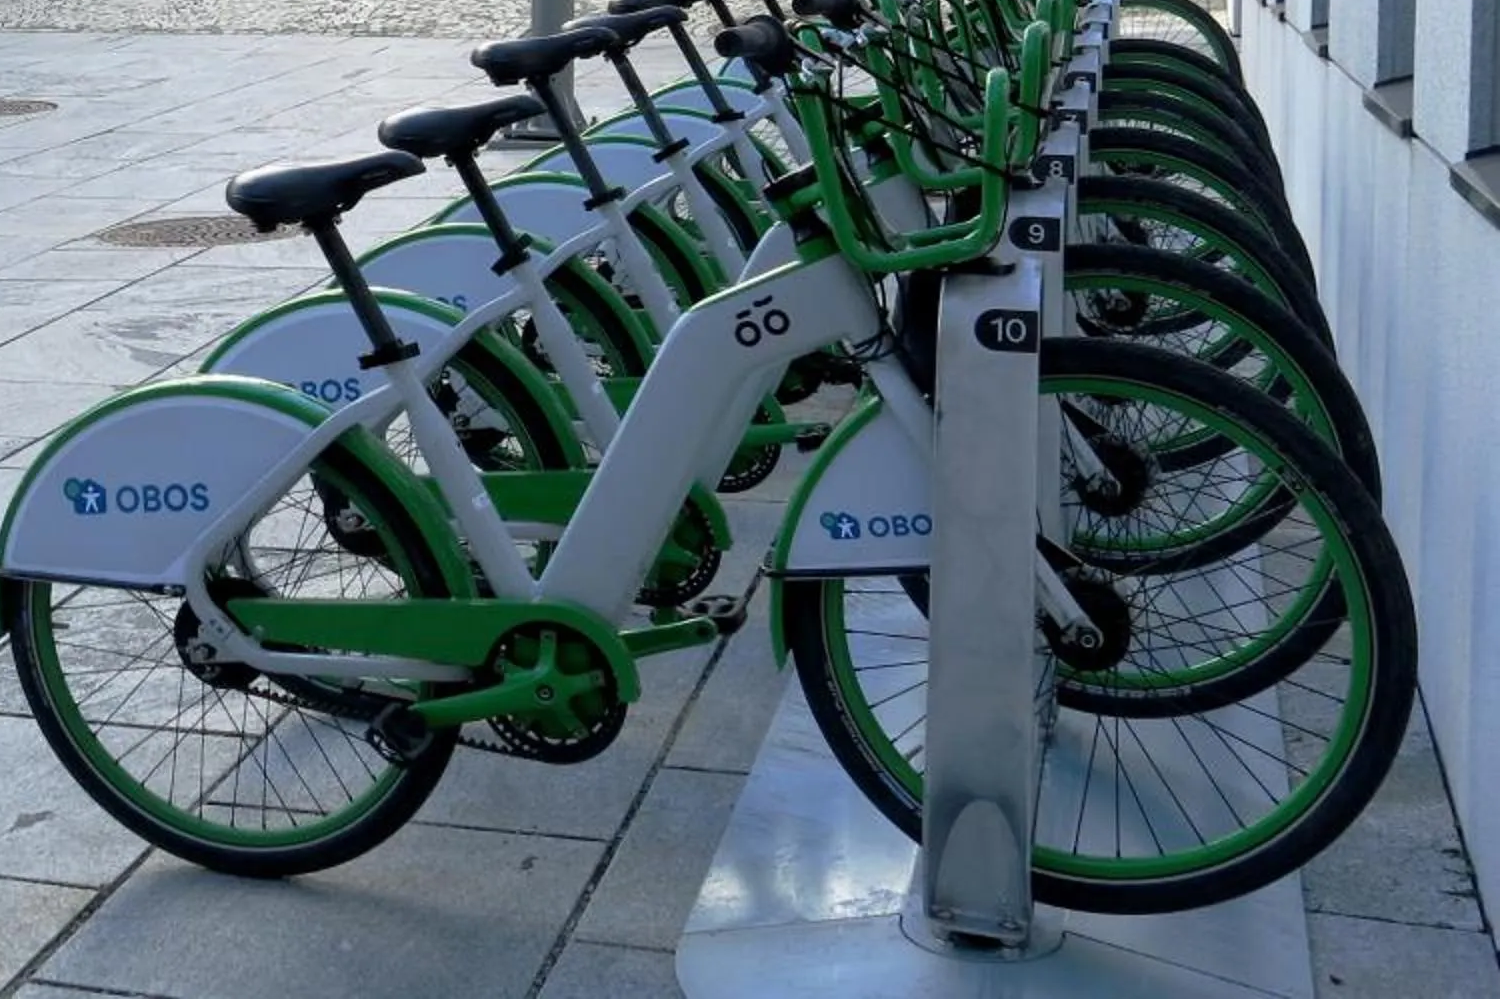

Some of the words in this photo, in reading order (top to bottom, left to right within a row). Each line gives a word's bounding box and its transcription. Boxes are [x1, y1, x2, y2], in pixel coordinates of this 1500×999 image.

[1049, 160, 1064, 178] 8
[1027, 223, 1046, 244] 9
[988, 316, 1028, 344] 10
[287, 377, 361, 403] BOS
[115, 482, 210, 514] OBOS
[867, 513, 934, 538] OBO
